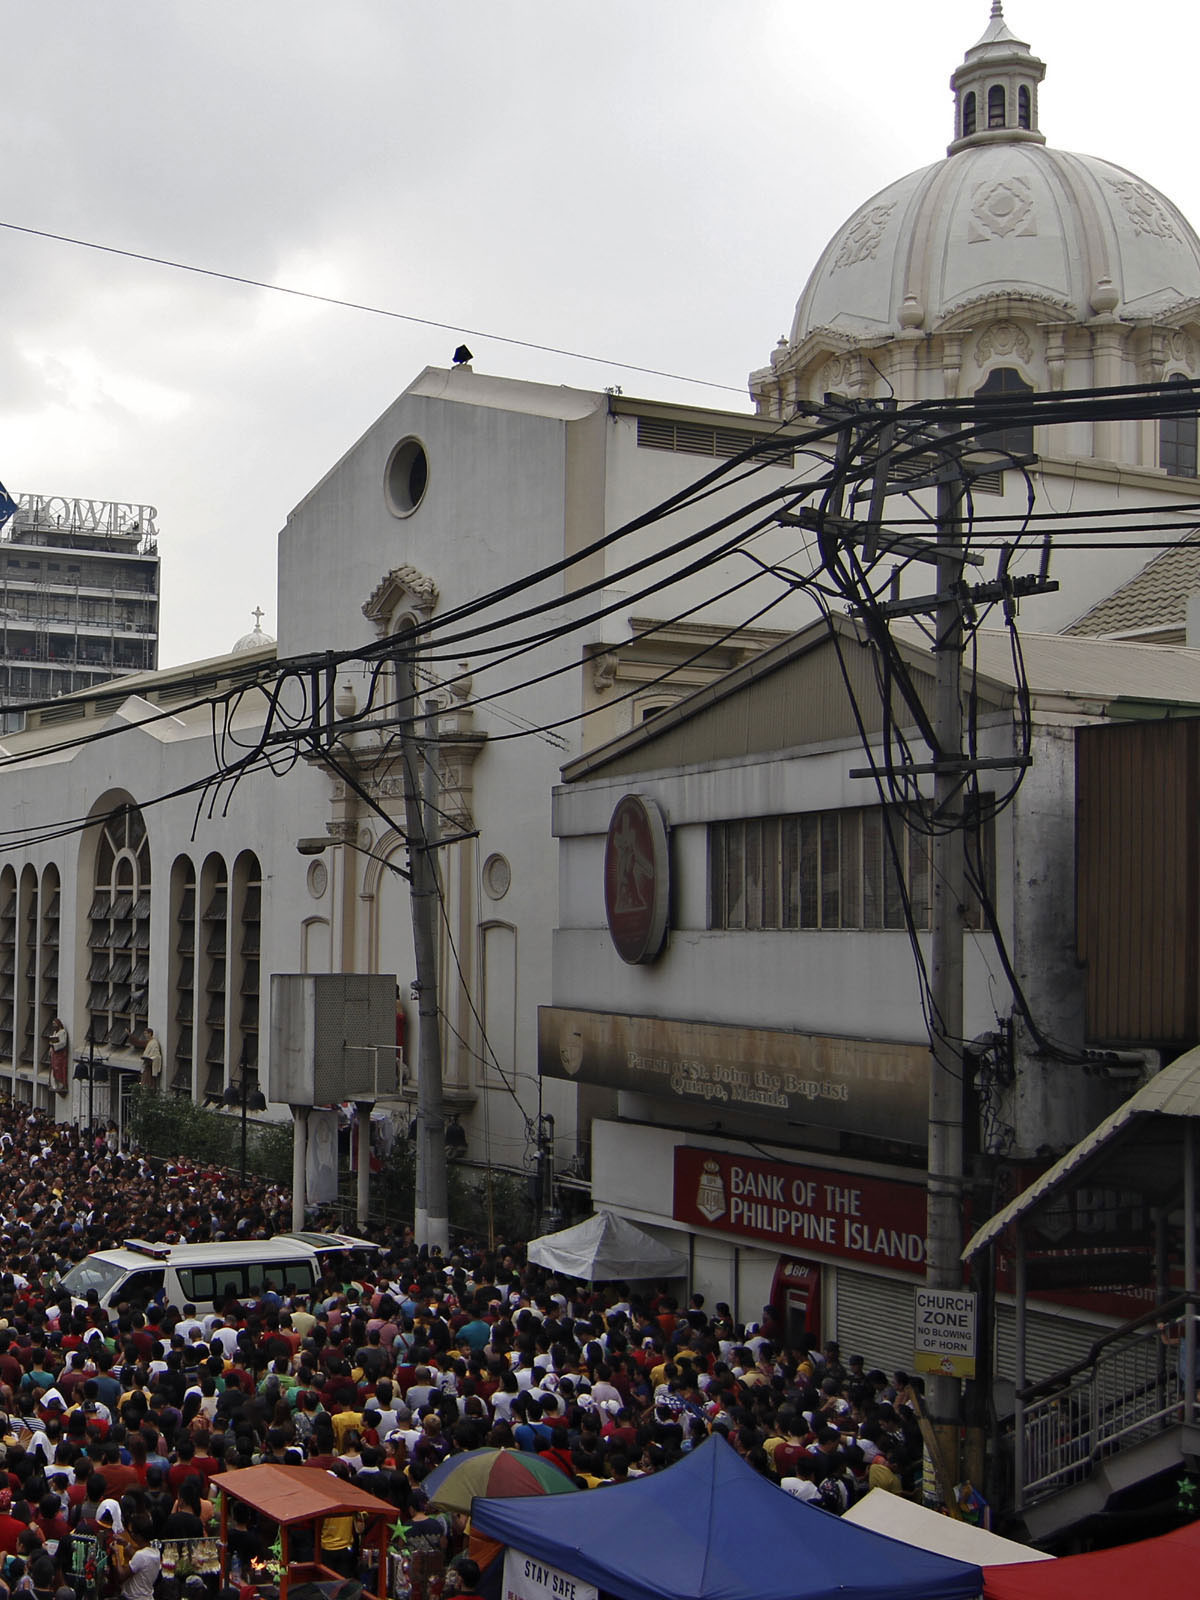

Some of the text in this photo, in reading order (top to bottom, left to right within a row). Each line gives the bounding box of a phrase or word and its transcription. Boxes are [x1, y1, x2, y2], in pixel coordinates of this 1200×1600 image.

[19, 493, 160, 536] TOWER
[627, 1050, 671, 1074] Parish
[671, 1059, 689, 1079] of
[711, 1064, 753, 1086] John
[753, 1069, 781, 1092] the
[784, 1074, 848, 1101] Baptist
[670, 1075, 789, 1108] Quiapo, Manila
[730, 1166, 862, 1217] BANK OF THE
[730, 1196, 928, 1264] PHILIPPINE ISLAND
[792, 1264, 809, 1278] BPI
[917, 1294, 973, 1312] CHURCH
[923, 1310, 968, 1328] ZONE
[918, 1327, 972, 1340] NO BLOWING
[923, 1338, 967, 1351] OF HORN
[524, 1560, 576, 1600] STAY SAFE
